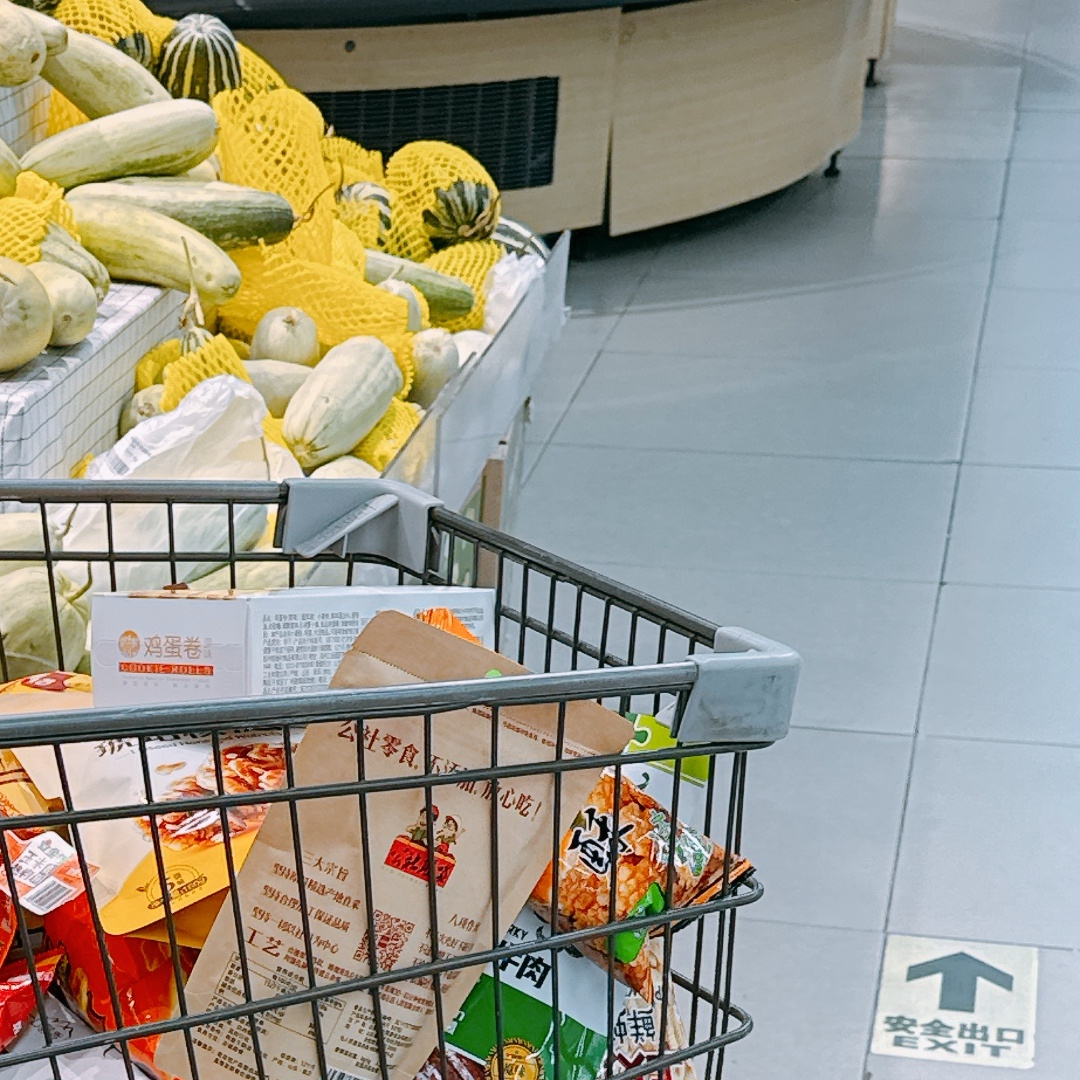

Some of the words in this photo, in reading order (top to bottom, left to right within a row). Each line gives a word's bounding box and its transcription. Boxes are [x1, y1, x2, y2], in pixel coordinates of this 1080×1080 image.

[143, 634, 201, 660] 鸡蛋卷
[299, 850, 352, 882] 三大宗旨
[884, 1015, 1024, 1044] 安全出口
[893, 1035, 1012, 1057] EXIT
